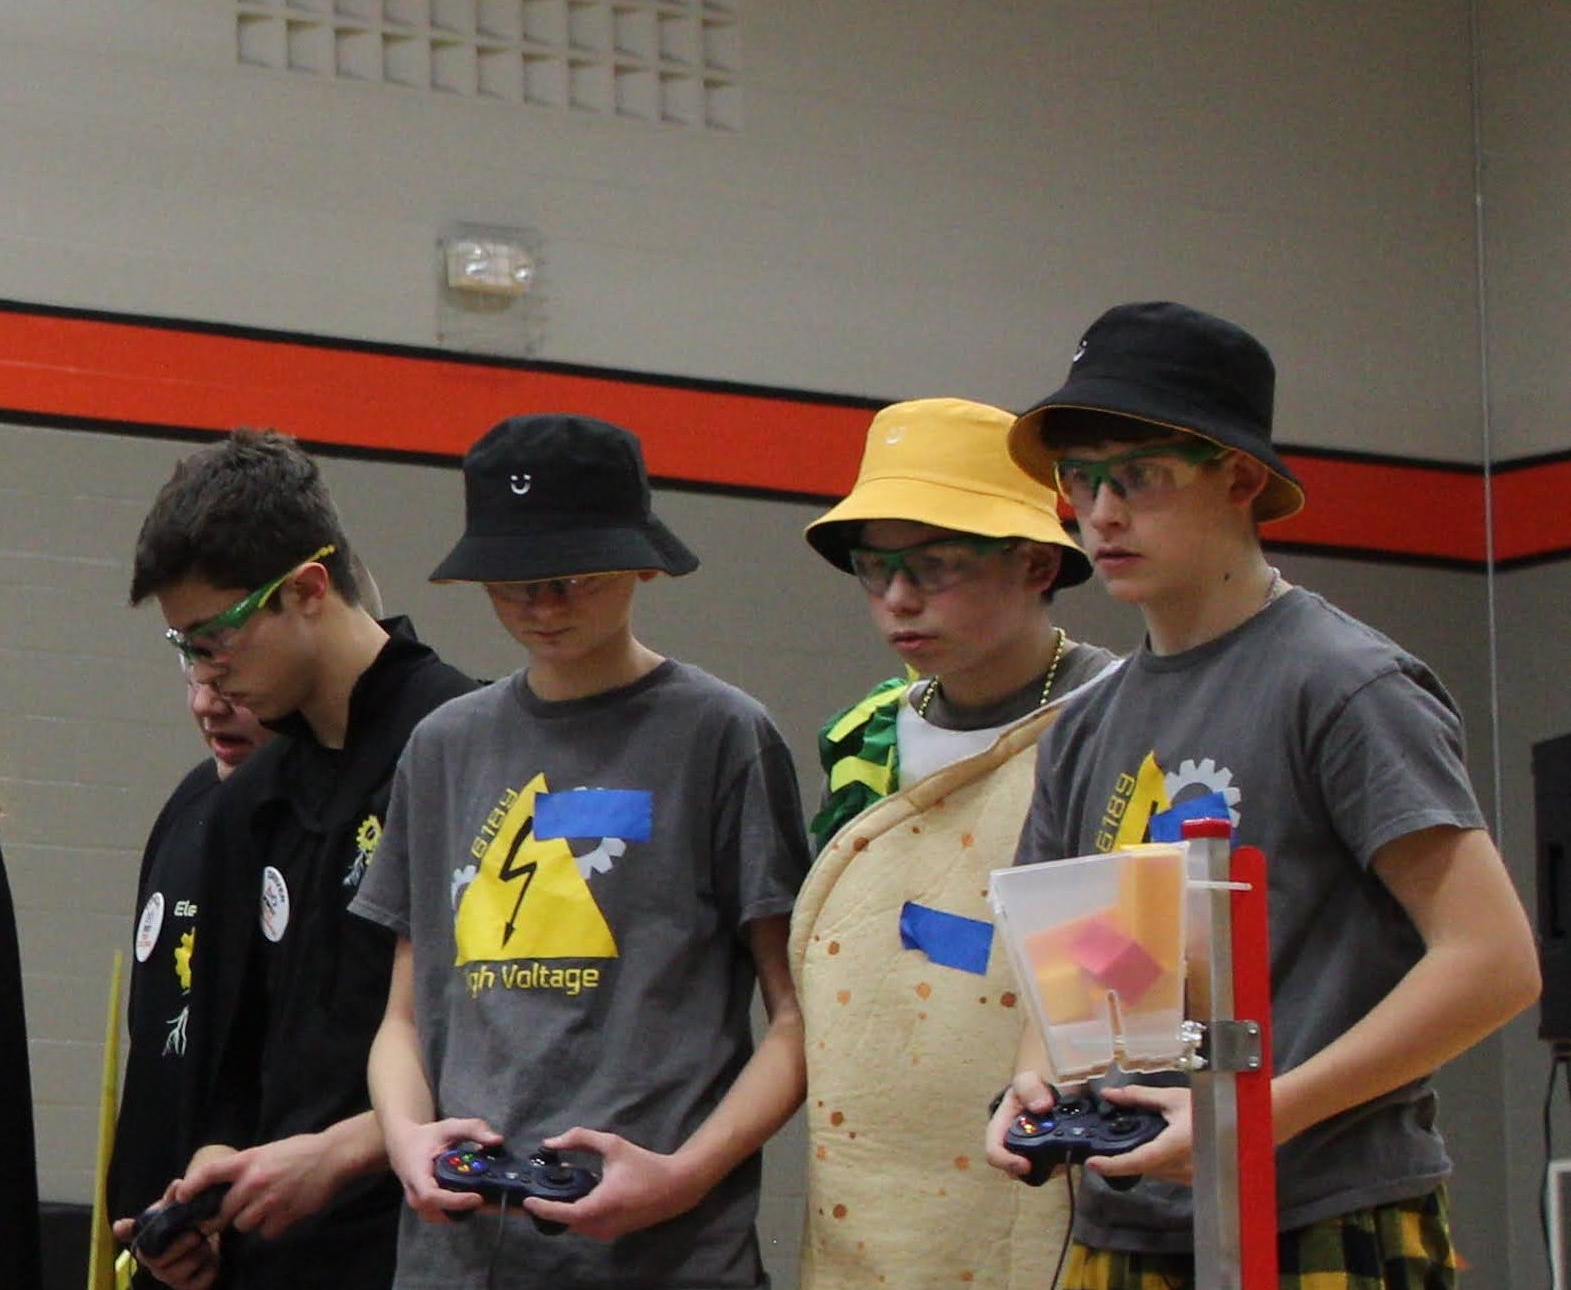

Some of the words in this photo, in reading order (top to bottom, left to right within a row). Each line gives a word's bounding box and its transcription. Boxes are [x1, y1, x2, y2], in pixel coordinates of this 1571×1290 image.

[1096, 772, 1136, 853] 6189
[174, 901, 198, 917] Ele
[501, 962, 601, 996] Voltage
